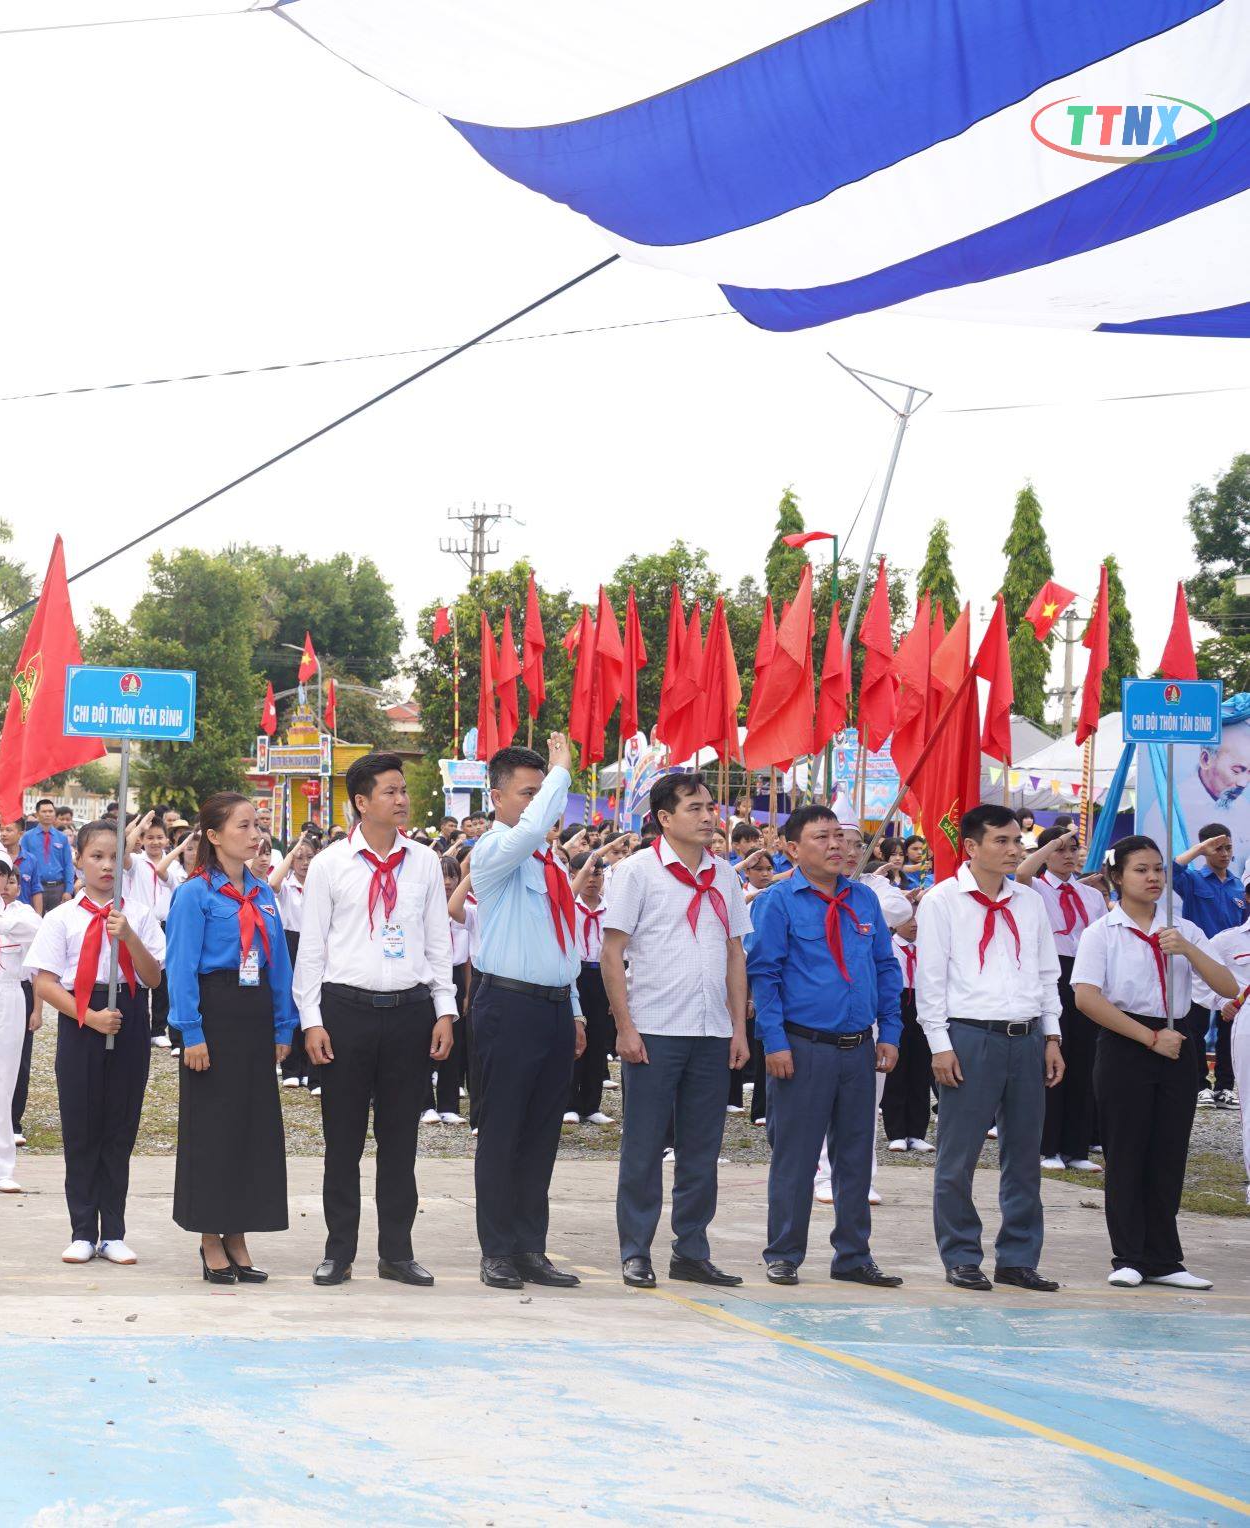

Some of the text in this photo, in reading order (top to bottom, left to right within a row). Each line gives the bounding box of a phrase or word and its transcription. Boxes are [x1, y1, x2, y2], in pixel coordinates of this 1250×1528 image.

[73, 702, 183, 727] CHI ĐỘI THÔN YÊN BÌNH
[1132, 711, 1212, 734] CHI ĐỘI THÔN TÂN BÌNH
